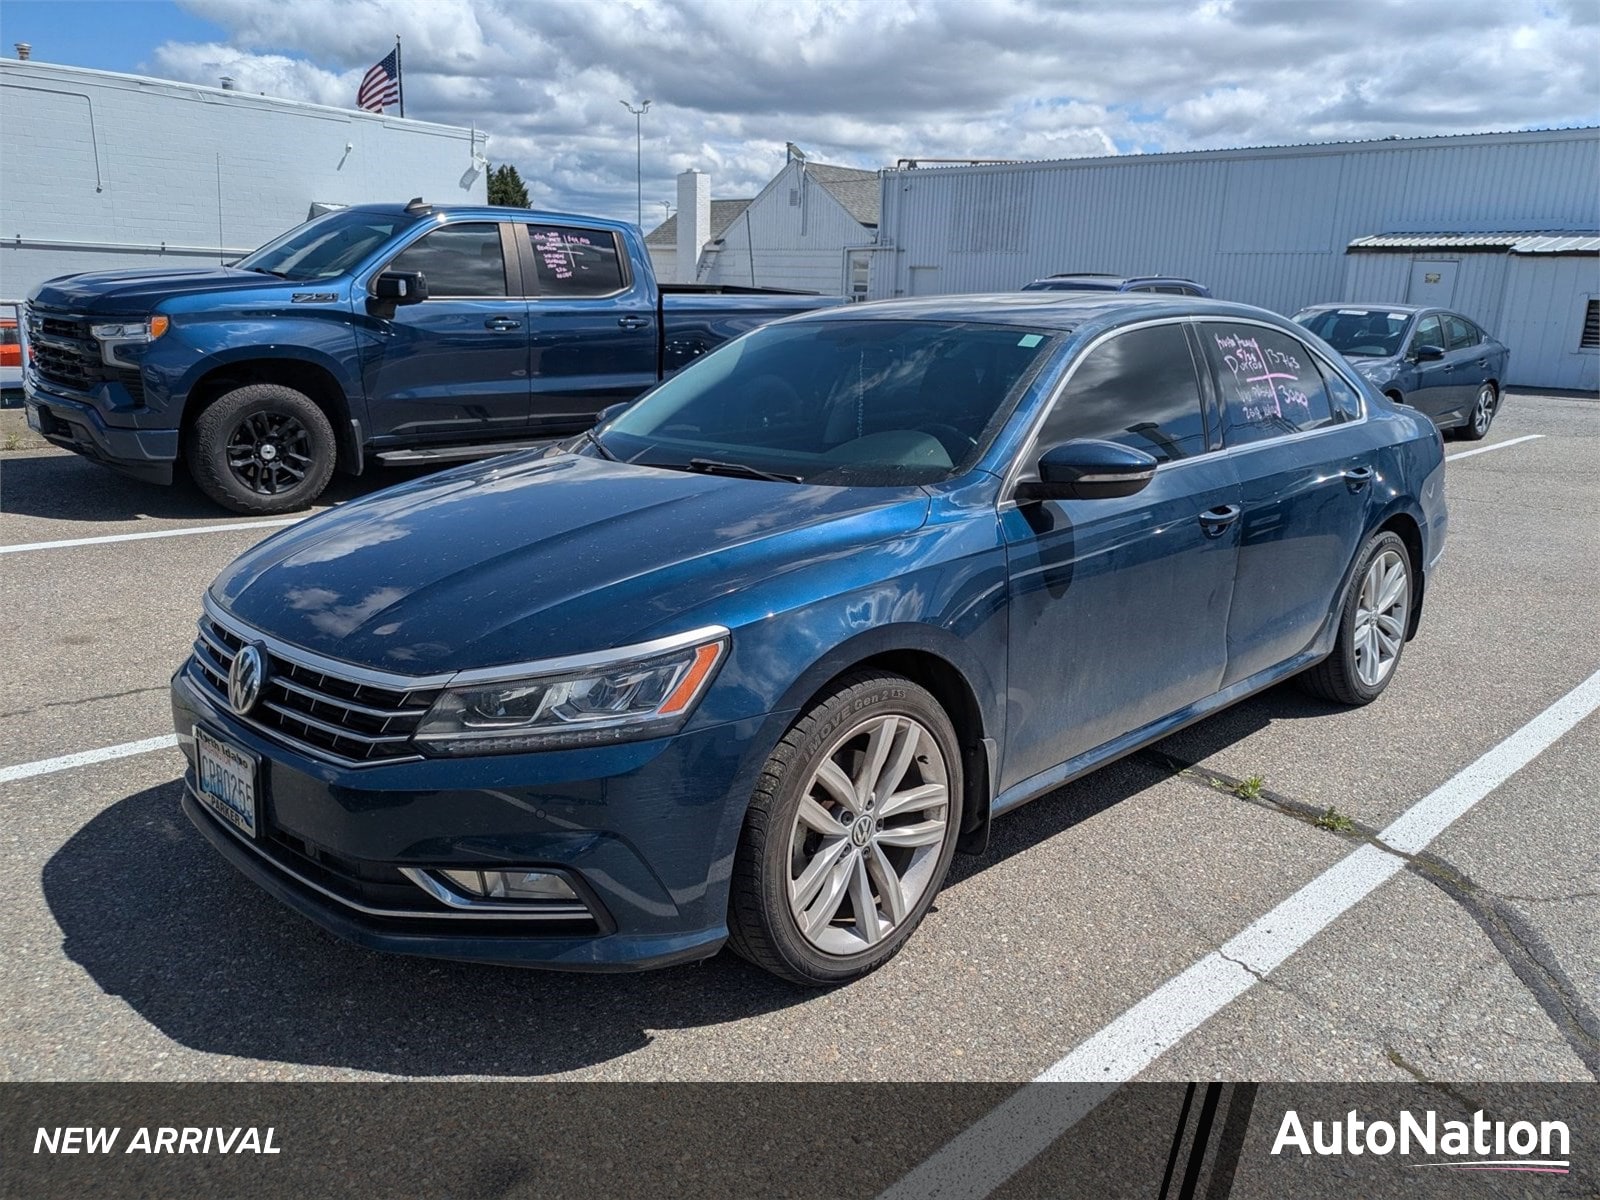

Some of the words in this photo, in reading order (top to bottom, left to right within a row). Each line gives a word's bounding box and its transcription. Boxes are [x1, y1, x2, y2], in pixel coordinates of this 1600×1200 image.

[854, 694, 879, 710] Gen
[881, 690, 889, 700] 2
[221, 745, 248, 769] Idaho
